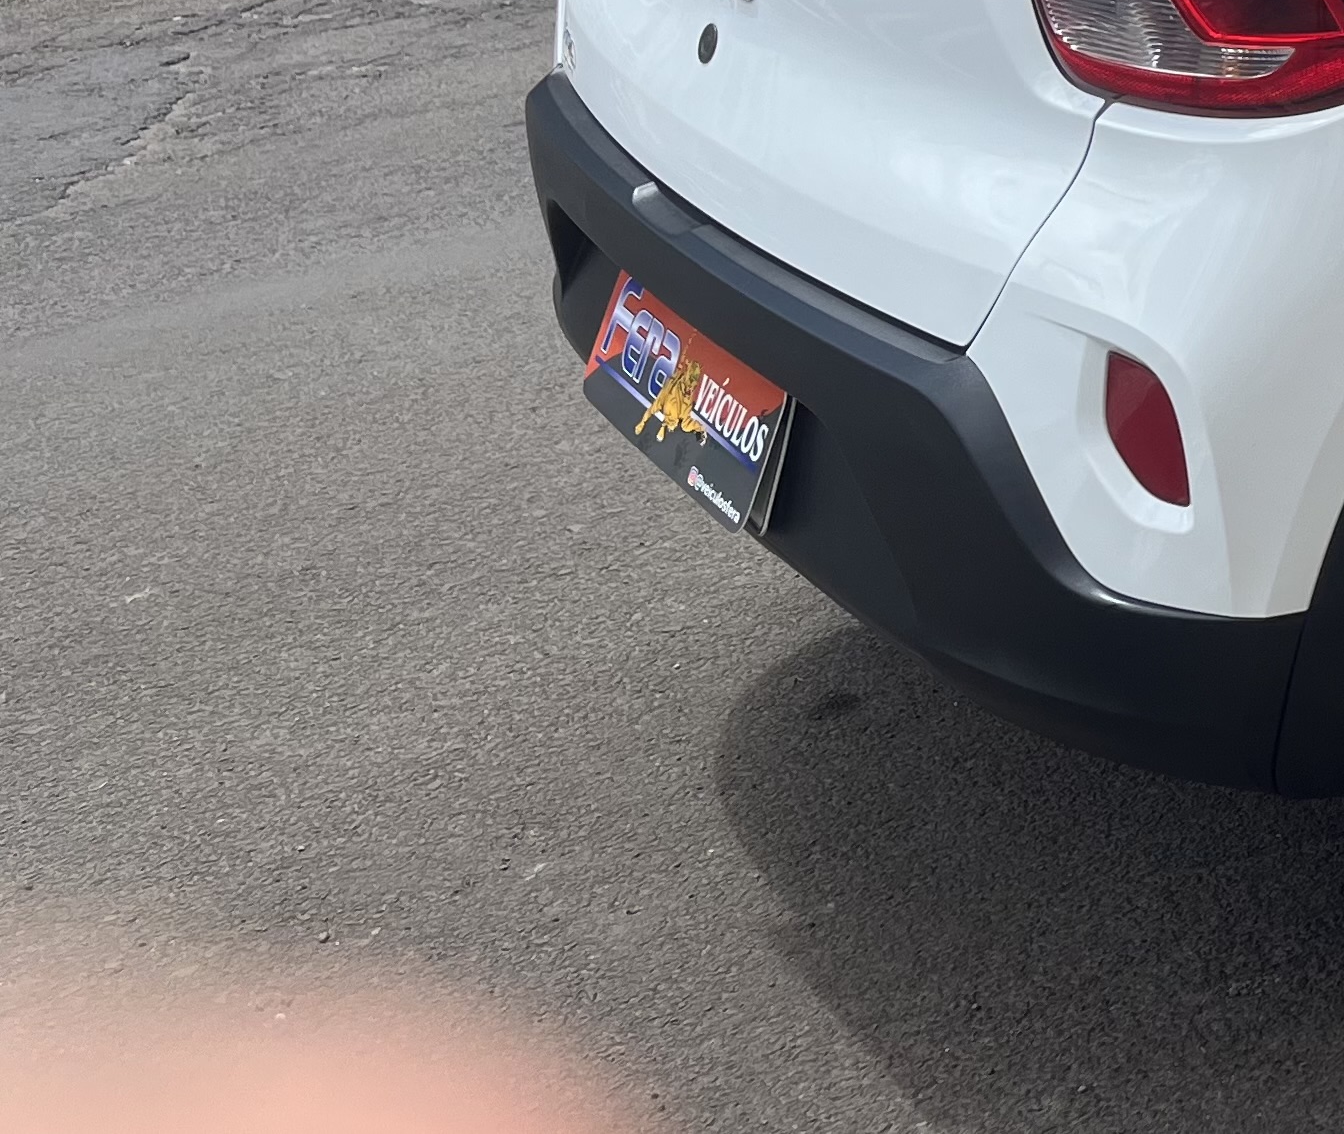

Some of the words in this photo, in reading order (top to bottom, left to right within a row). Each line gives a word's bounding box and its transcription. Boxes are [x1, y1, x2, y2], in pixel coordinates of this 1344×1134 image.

[600, 276, 681, 398] Fera
[694, 373, 769, 462] VEÍCULOS
[694, 473, 741, 524] @veiculosfera
